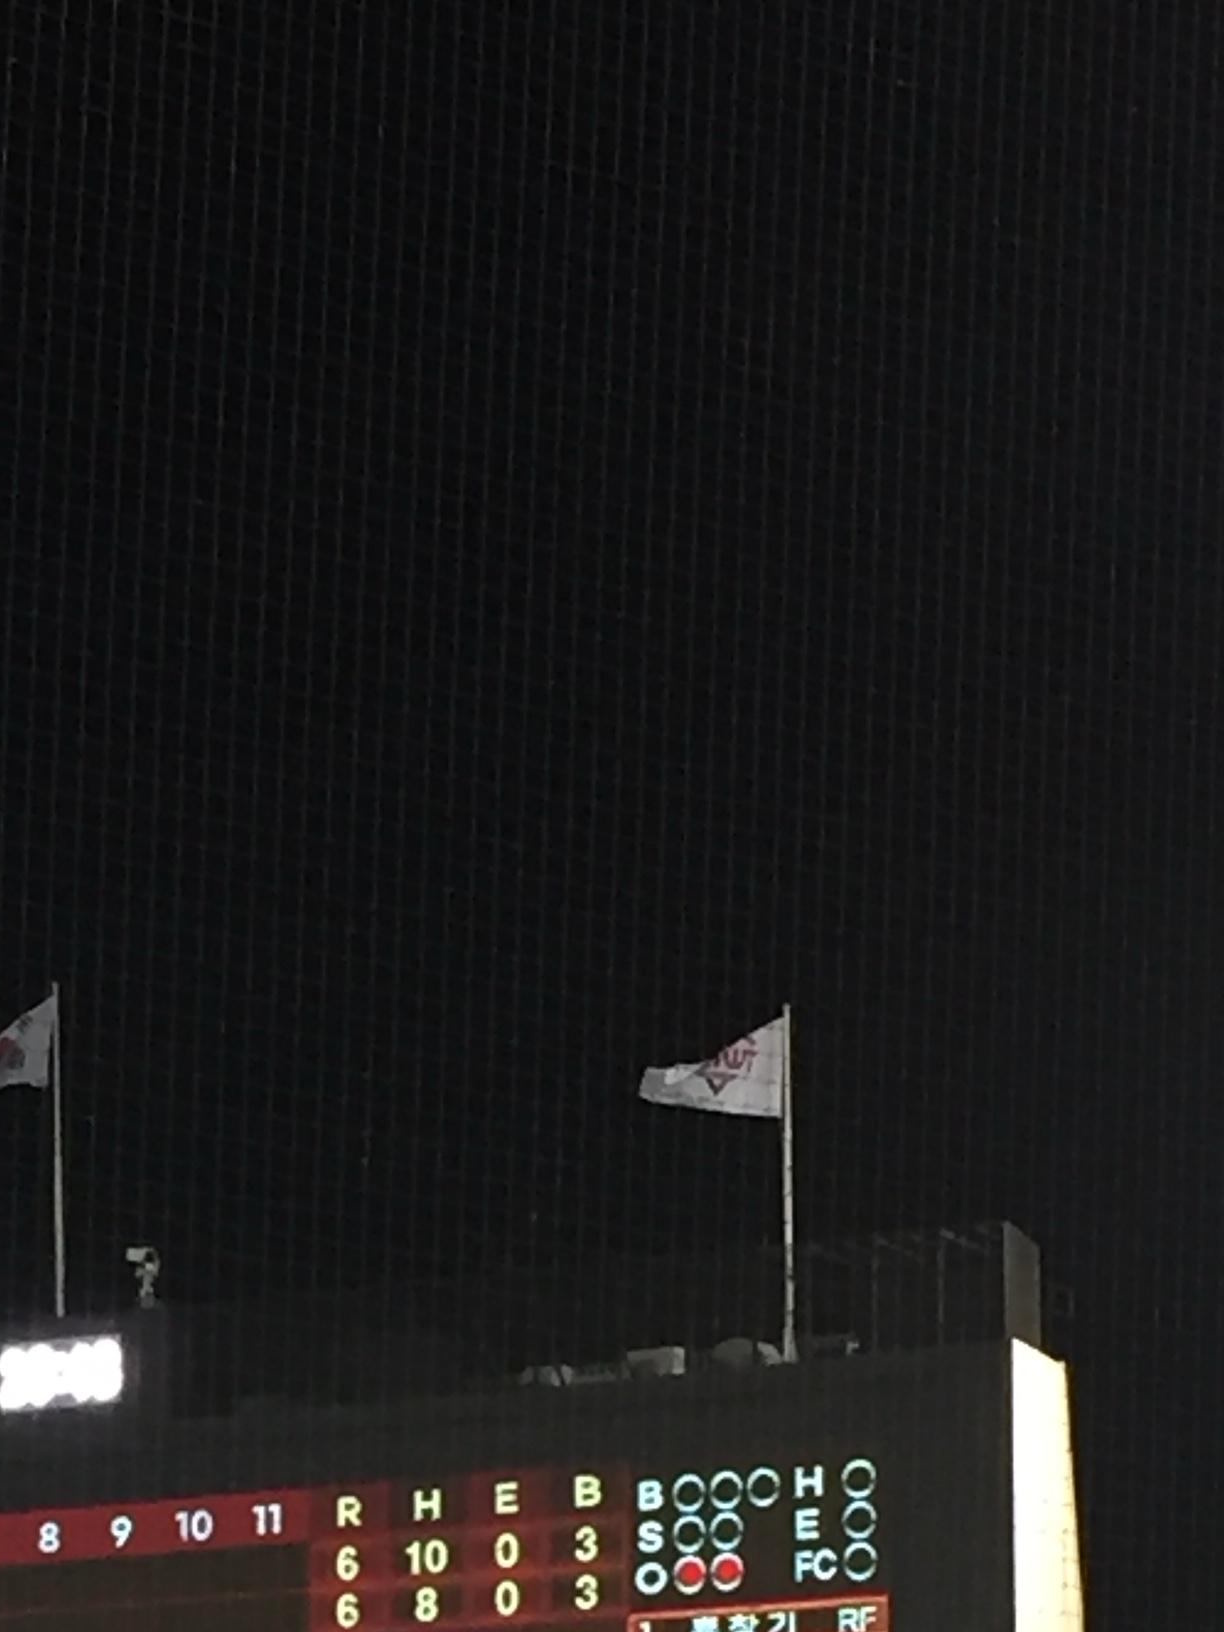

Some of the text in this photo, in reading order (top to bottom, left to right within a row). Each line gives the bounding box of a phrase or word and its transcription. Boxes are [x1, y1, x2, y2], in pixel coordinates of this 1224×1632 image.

[637, 1464, 824, 1512] B H
[38, 1522, 60, 1554] 8
[110, 1515, 133, 1548] 9
[175, 1509, 213, 1542] 10
[252, 1503, 282, 1536] 11
[336, 1495, 362, 1528] R
[413, 1488, 441, 1522] H
[494, 1481, 519, 1515] E
[574, 1475, 602, 1508] B
[637, 1507, 820, 1554] S E
[336, 1545, 360, 1582] 6
[405, 1539, 448, 1576] 10
[494, 1532, 519, 1569] 0
[574, 1525, 598, 1563] 3
[634, 1547, 838, 1595] O FC
[336, 1593, 359, 1630] 6
[414, 1586, 439, 1623] 8
[494, 1580, 520, 1618] 0
[574, 1573, 599, 1611] 3
